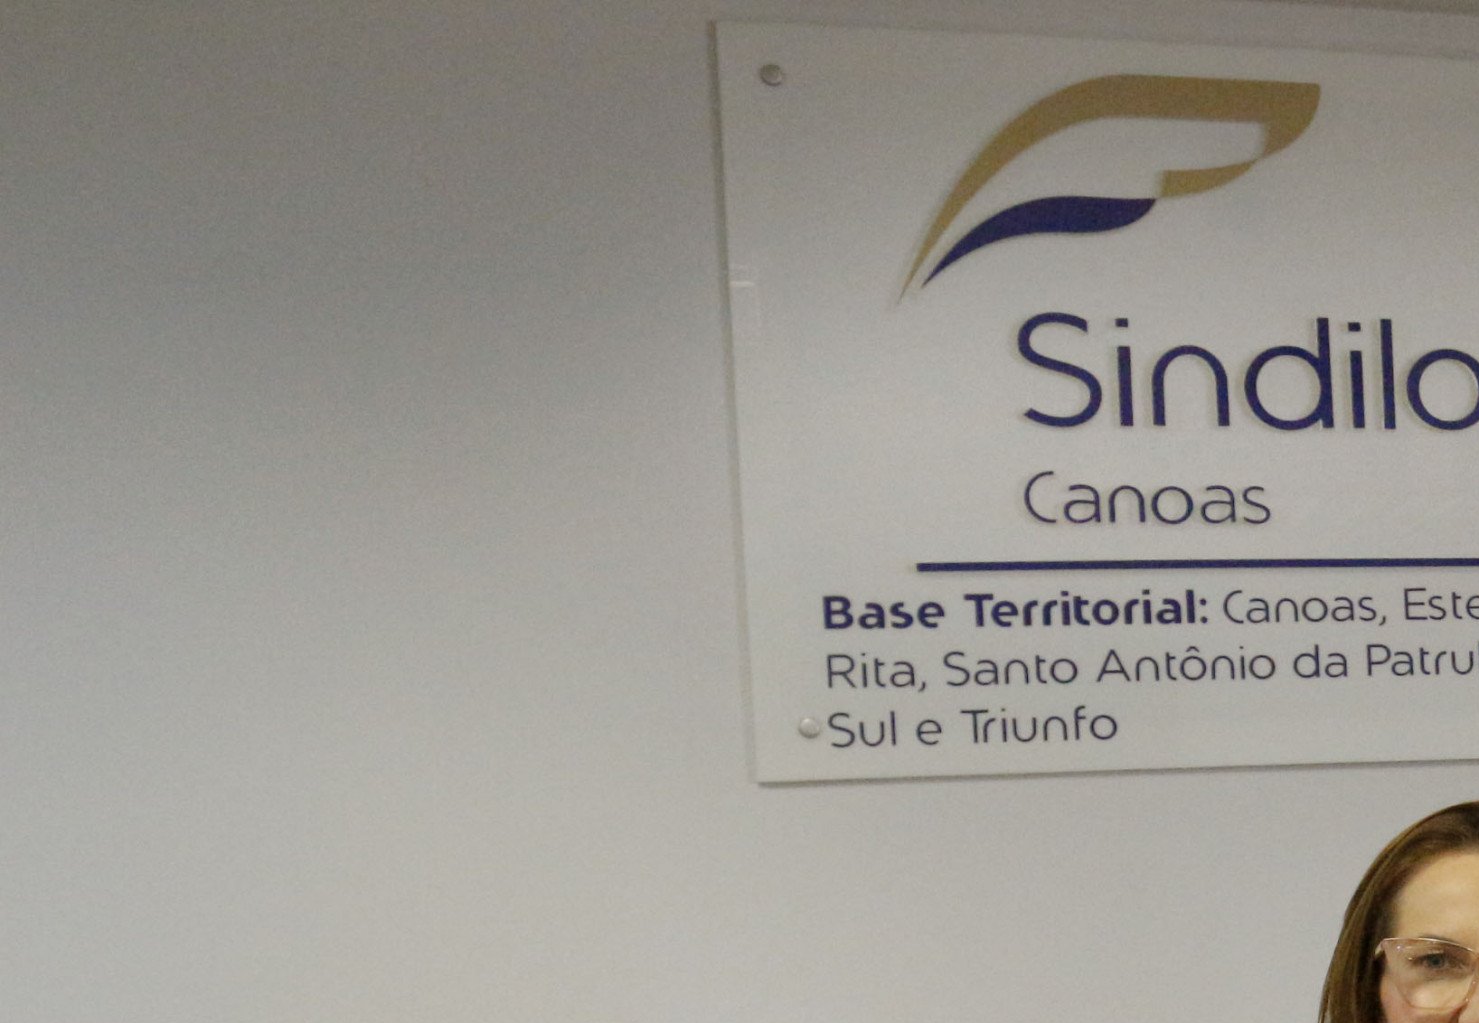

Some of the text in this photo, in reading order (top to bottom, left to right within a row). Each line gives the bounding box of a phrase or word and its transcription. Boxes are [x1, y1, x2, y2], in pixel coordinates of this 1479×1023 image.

[1022, 469, 1272, 526] Canoas
[821, 594, 946, 631] Base
[962, 588, 1209, 629] Territorial:
[1221, 588, 1388, 627] Canoas,
[825, 652, 928, 693] Rita,
[942, 649, 1080, 688] Santo
[1095, 644, 1277, 683] Antônio
[1292, 644, 1349, 680] da
[826, 703, 1119, 750] Sul e Triunfo
